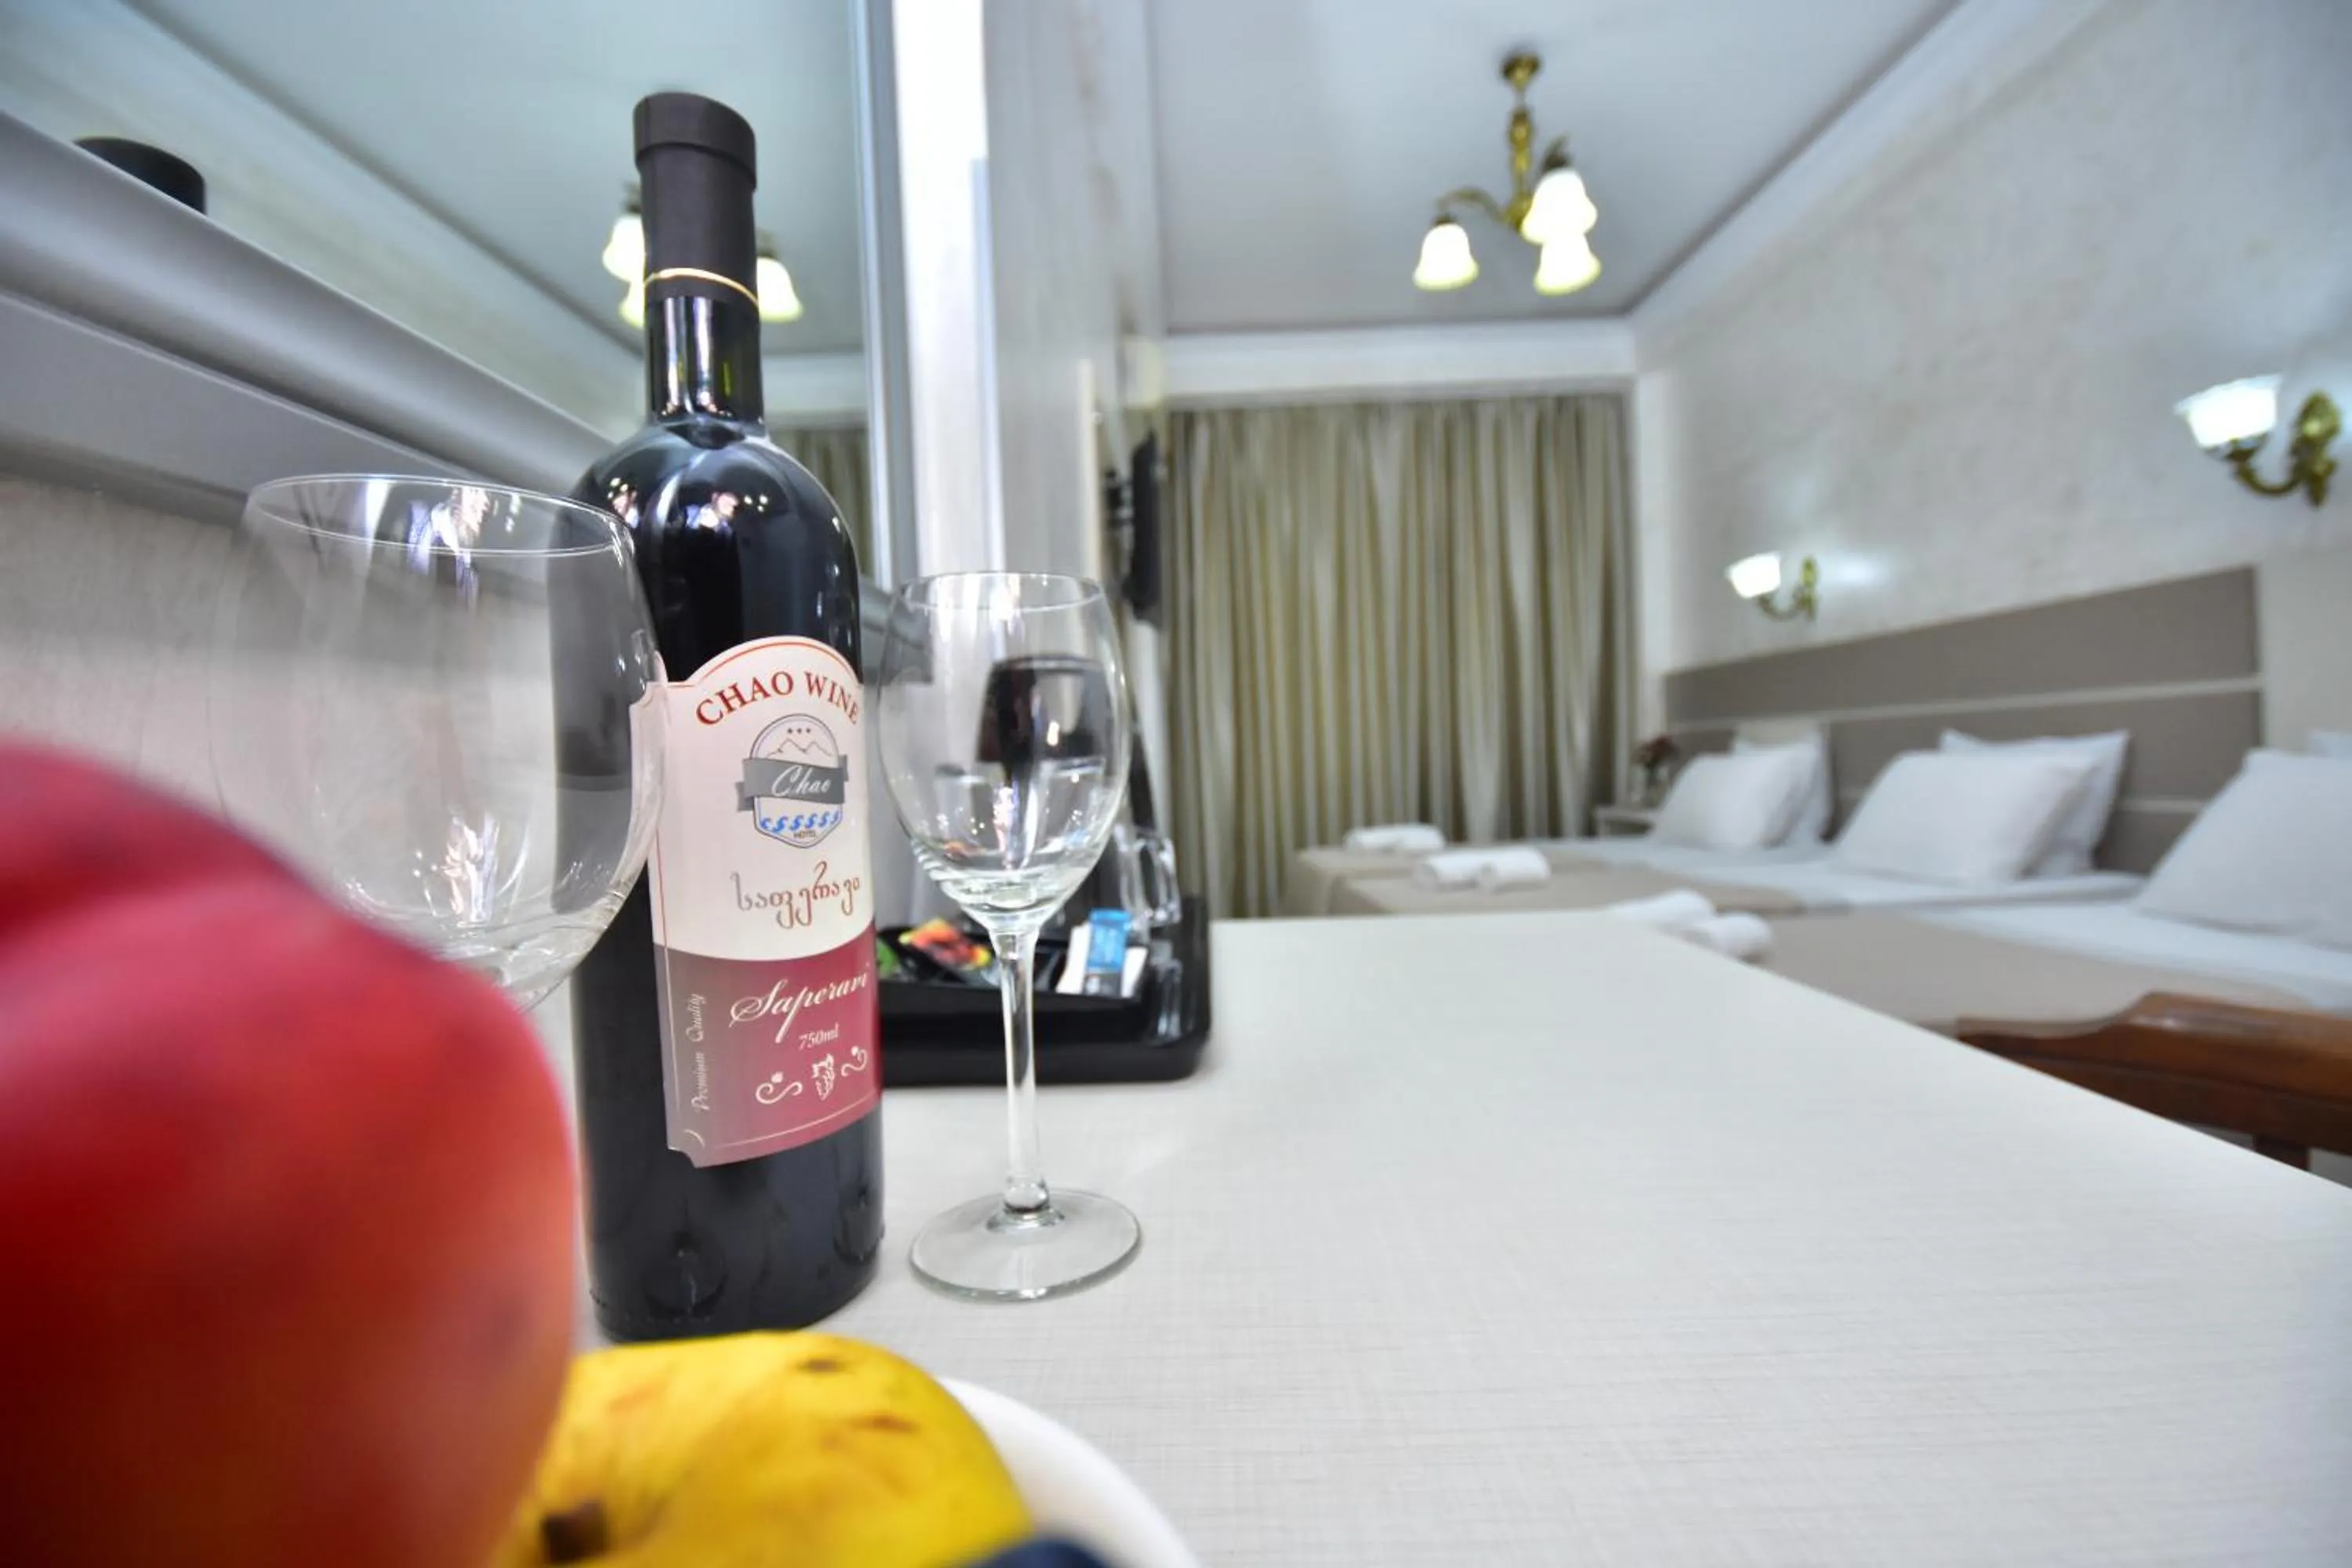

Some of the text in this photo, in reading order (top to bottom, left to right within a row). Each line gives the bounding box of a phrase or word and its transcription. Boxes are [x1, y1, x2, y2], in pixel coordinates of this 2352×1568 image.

[695, 671, 859, 726] CHAO WINE
[771, 764, 831, 797] Chao
[730, 860, 860, 929] საფერავი
[729, 960, 870, 1044] Saperavi
[685, 993, 710, 1110] Premium Quality
[798, 1022, 840, 1051] 750ml
